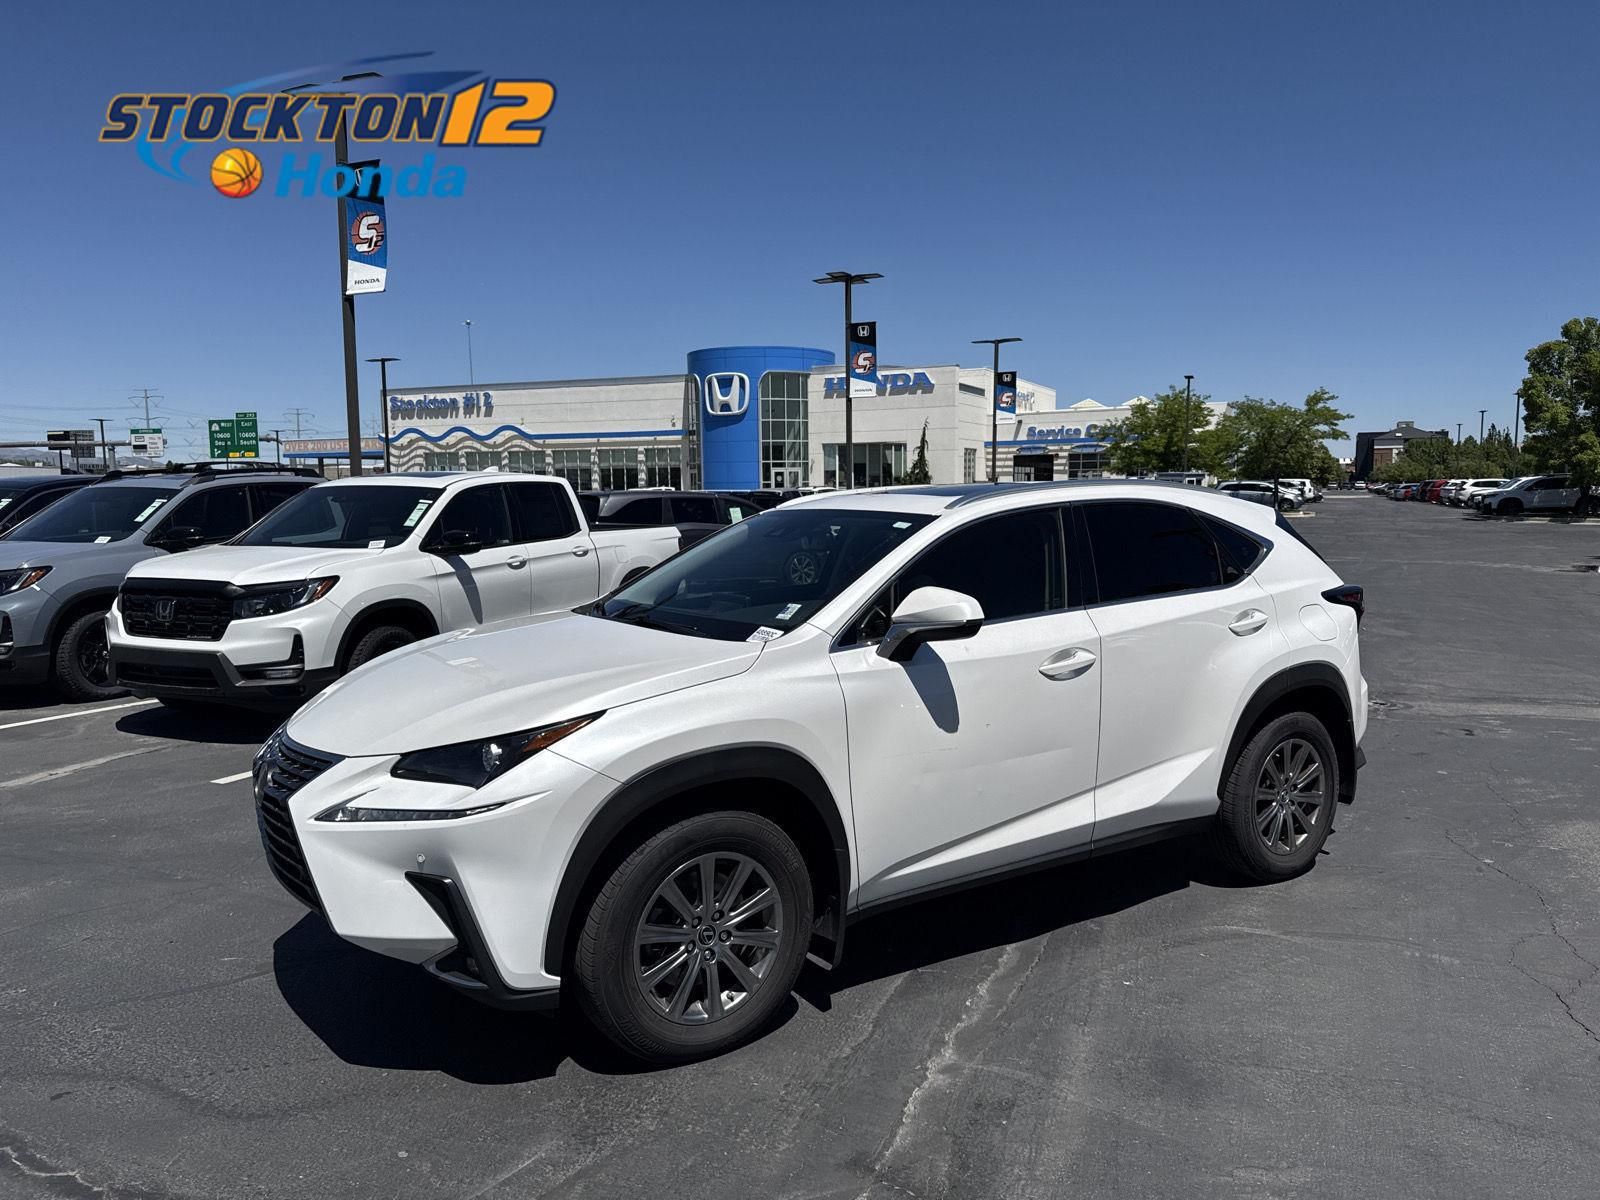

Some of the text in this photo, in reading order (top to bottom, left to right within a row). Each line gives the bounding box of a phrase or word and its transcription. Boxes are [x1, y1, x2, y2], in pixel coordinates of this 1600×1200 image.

[354, 277, 380, 286] HONDA
[824, 372, 935, 393] HNDA
[390, 391, 492, 411] Stockton #12
[1026, 425, 1082, 438] Service
[284, 441, 309, 452] OVER
[310, 441, 328, 450] 200
[330, 440, 349, 449] USE
